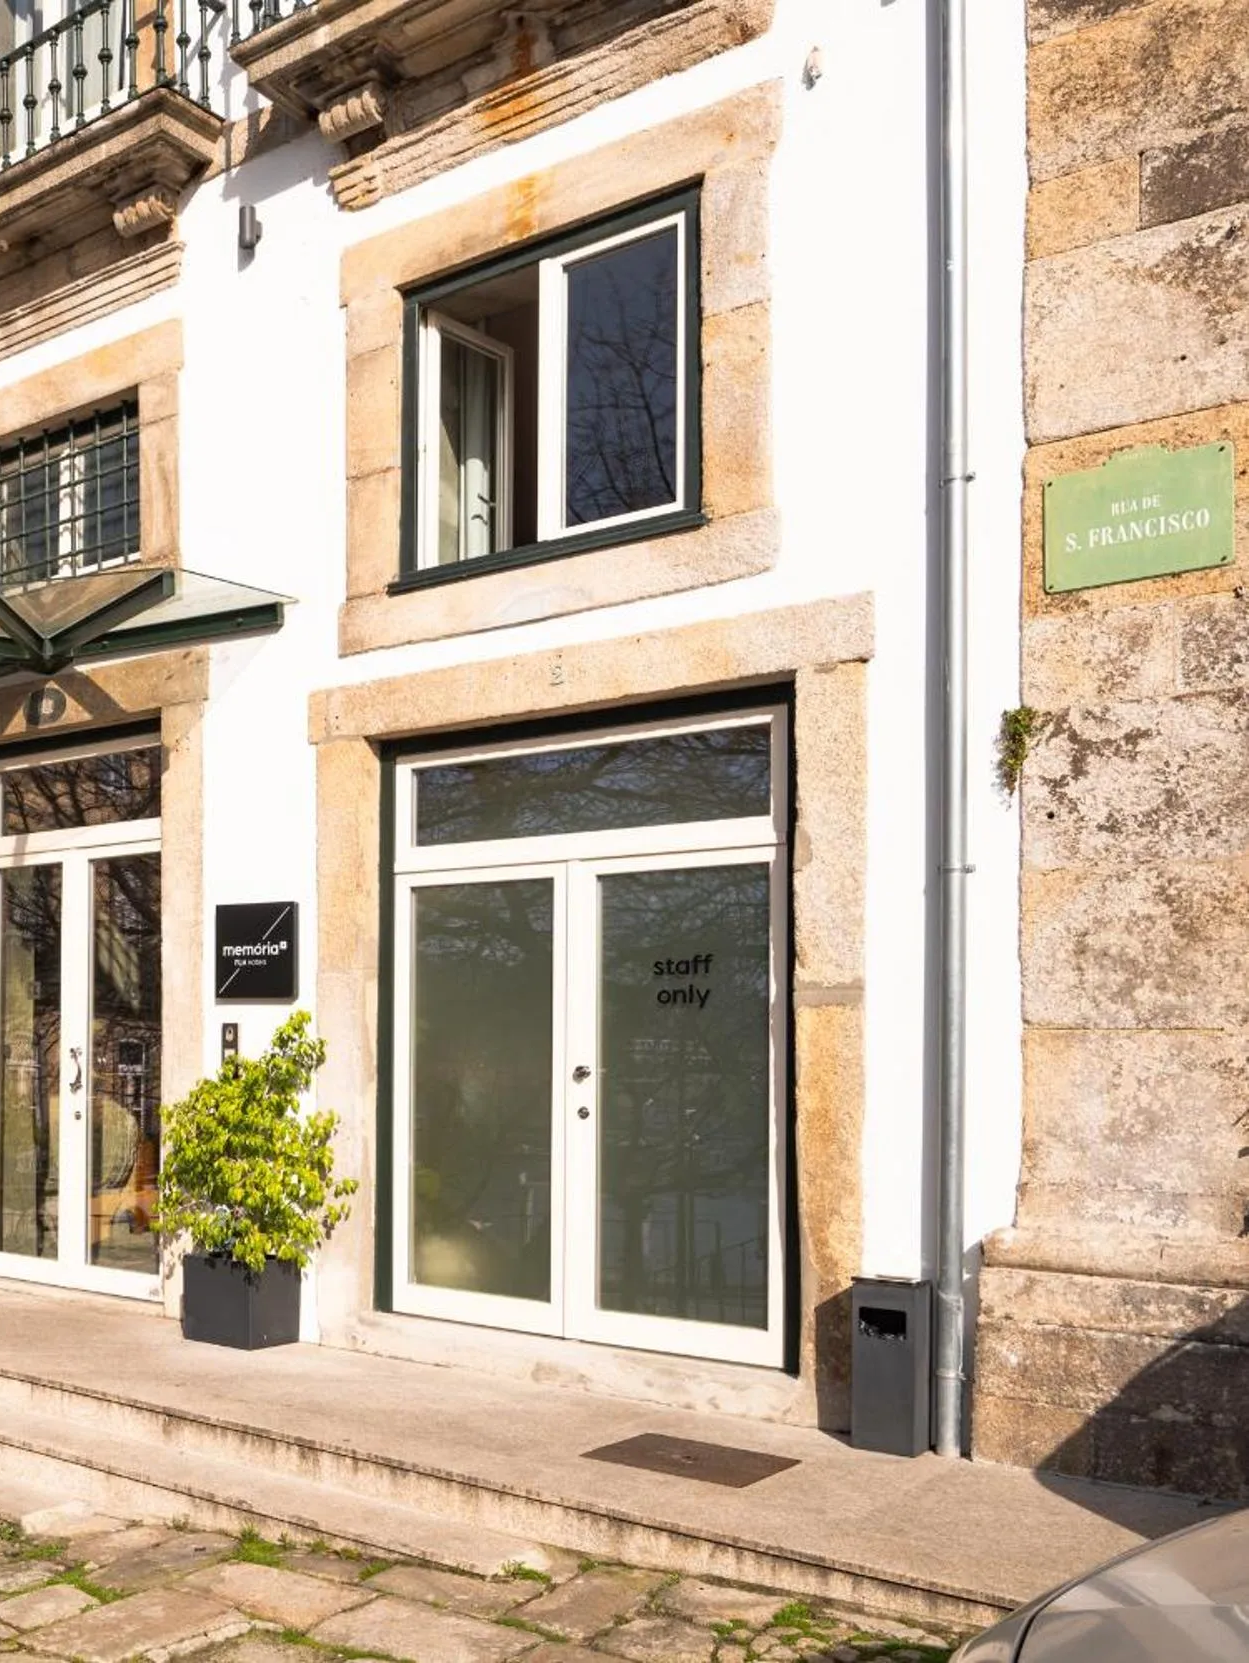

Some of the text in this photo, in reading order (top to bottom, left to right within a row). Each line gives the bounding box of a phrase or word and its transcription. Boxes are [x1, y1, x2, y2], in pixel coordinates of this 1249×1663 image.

[1110, 494, 1162, 516] RUA DE
[1065, 508, 1210, 552] S. FRANCISCO
[222, 940, 279, 957] memória
[653, 953, 714, 975] staff
[657, 984, 711, 1009] only
